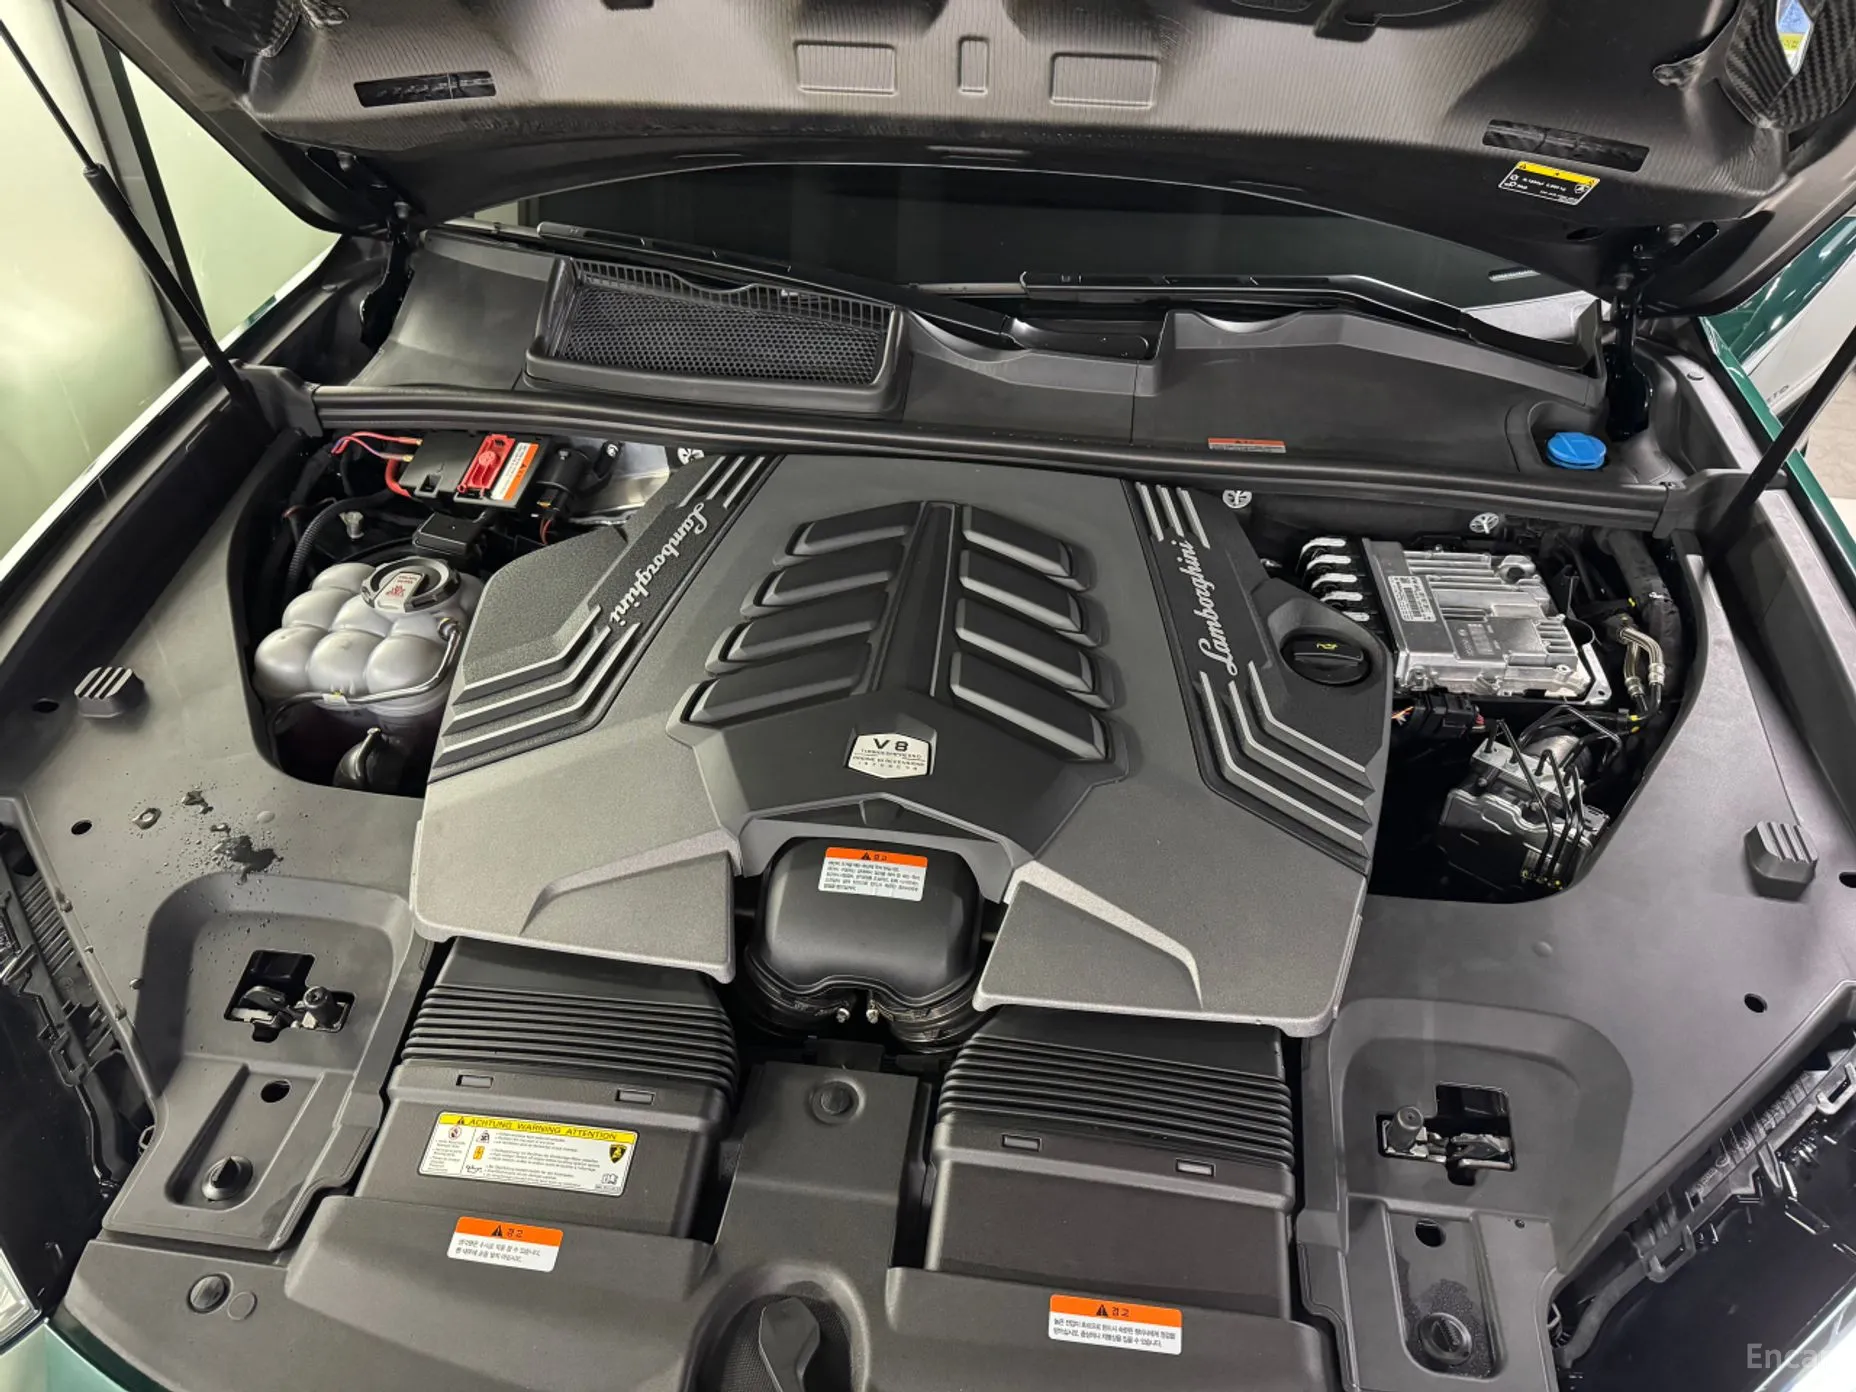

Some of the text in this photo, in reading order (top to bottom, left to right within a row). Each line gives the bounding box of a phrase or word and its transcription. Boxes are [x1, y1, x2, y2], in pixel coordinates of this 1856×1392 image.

[610, 502, 708, 627] Lamborghini
[1171, 539, 1238, 677] Lamborghini
[469, 1118, 618, 1140] ACHTUNG WARNING ATTENTION
